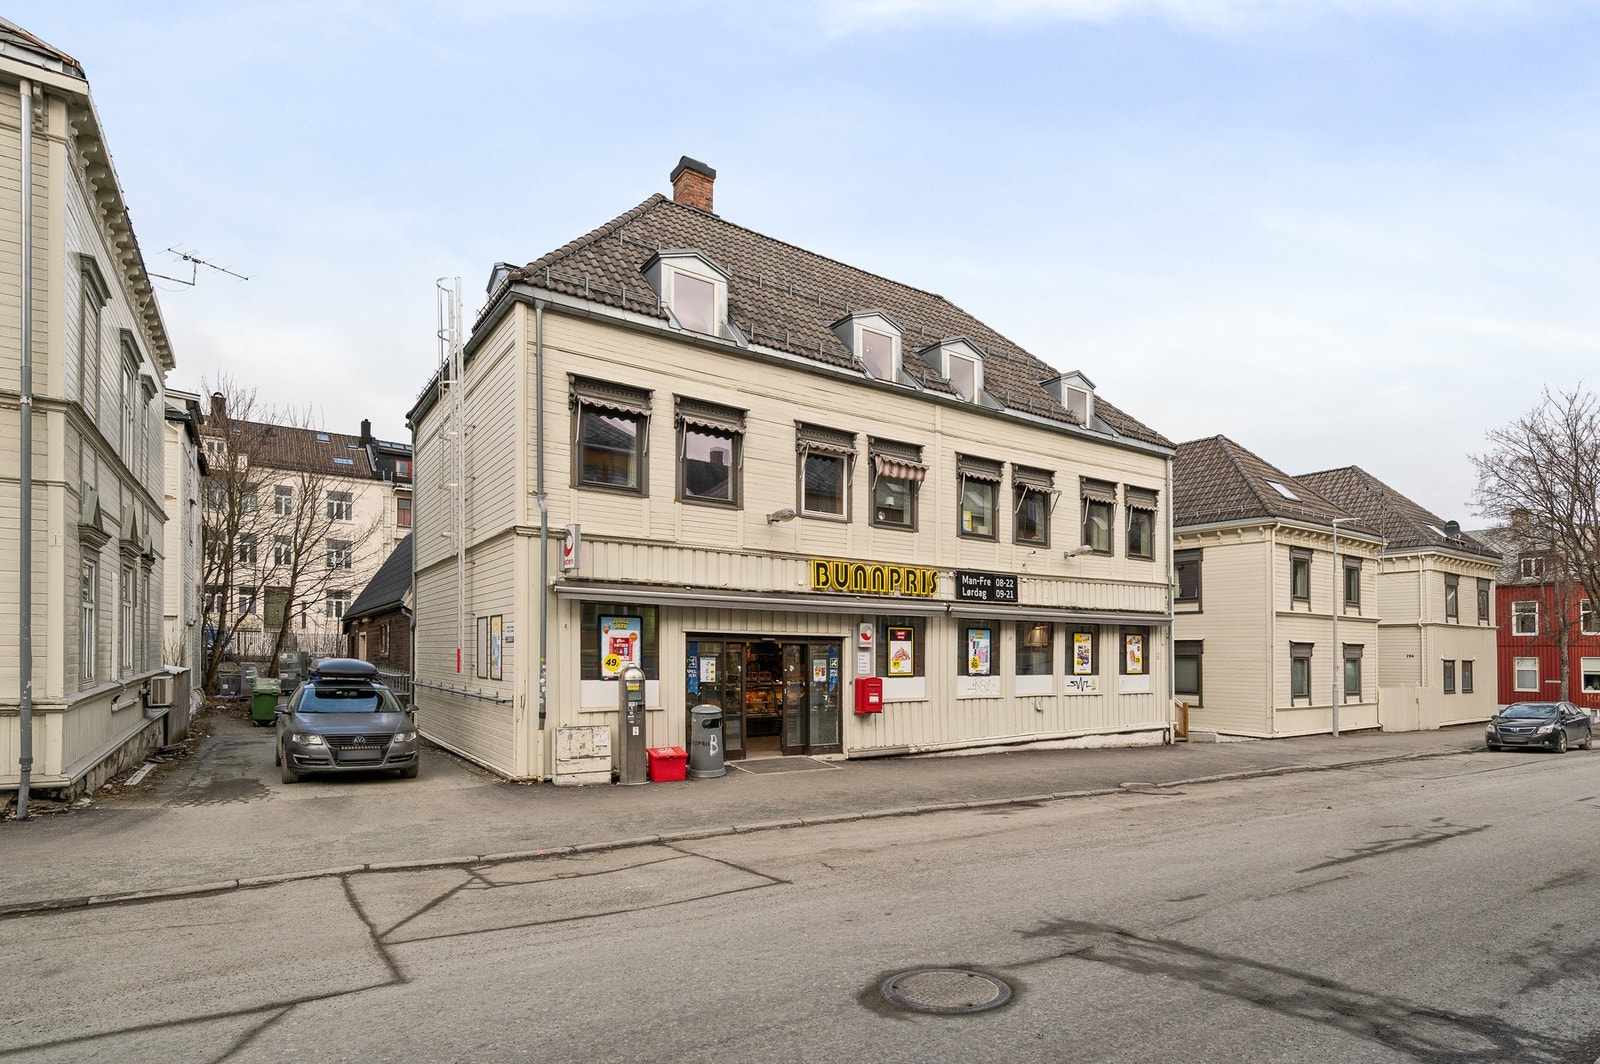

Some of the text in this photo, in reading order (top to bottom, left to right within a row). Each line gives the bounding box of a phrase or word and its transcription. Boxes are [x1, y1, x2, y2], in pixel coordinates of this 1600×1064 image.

[811, 559, 939, 595] BUNNPRIS
[962, 574, 1014, 588] Man-Fre 08-22
[962, 586, 1014, 600] Lørdag 09-21
